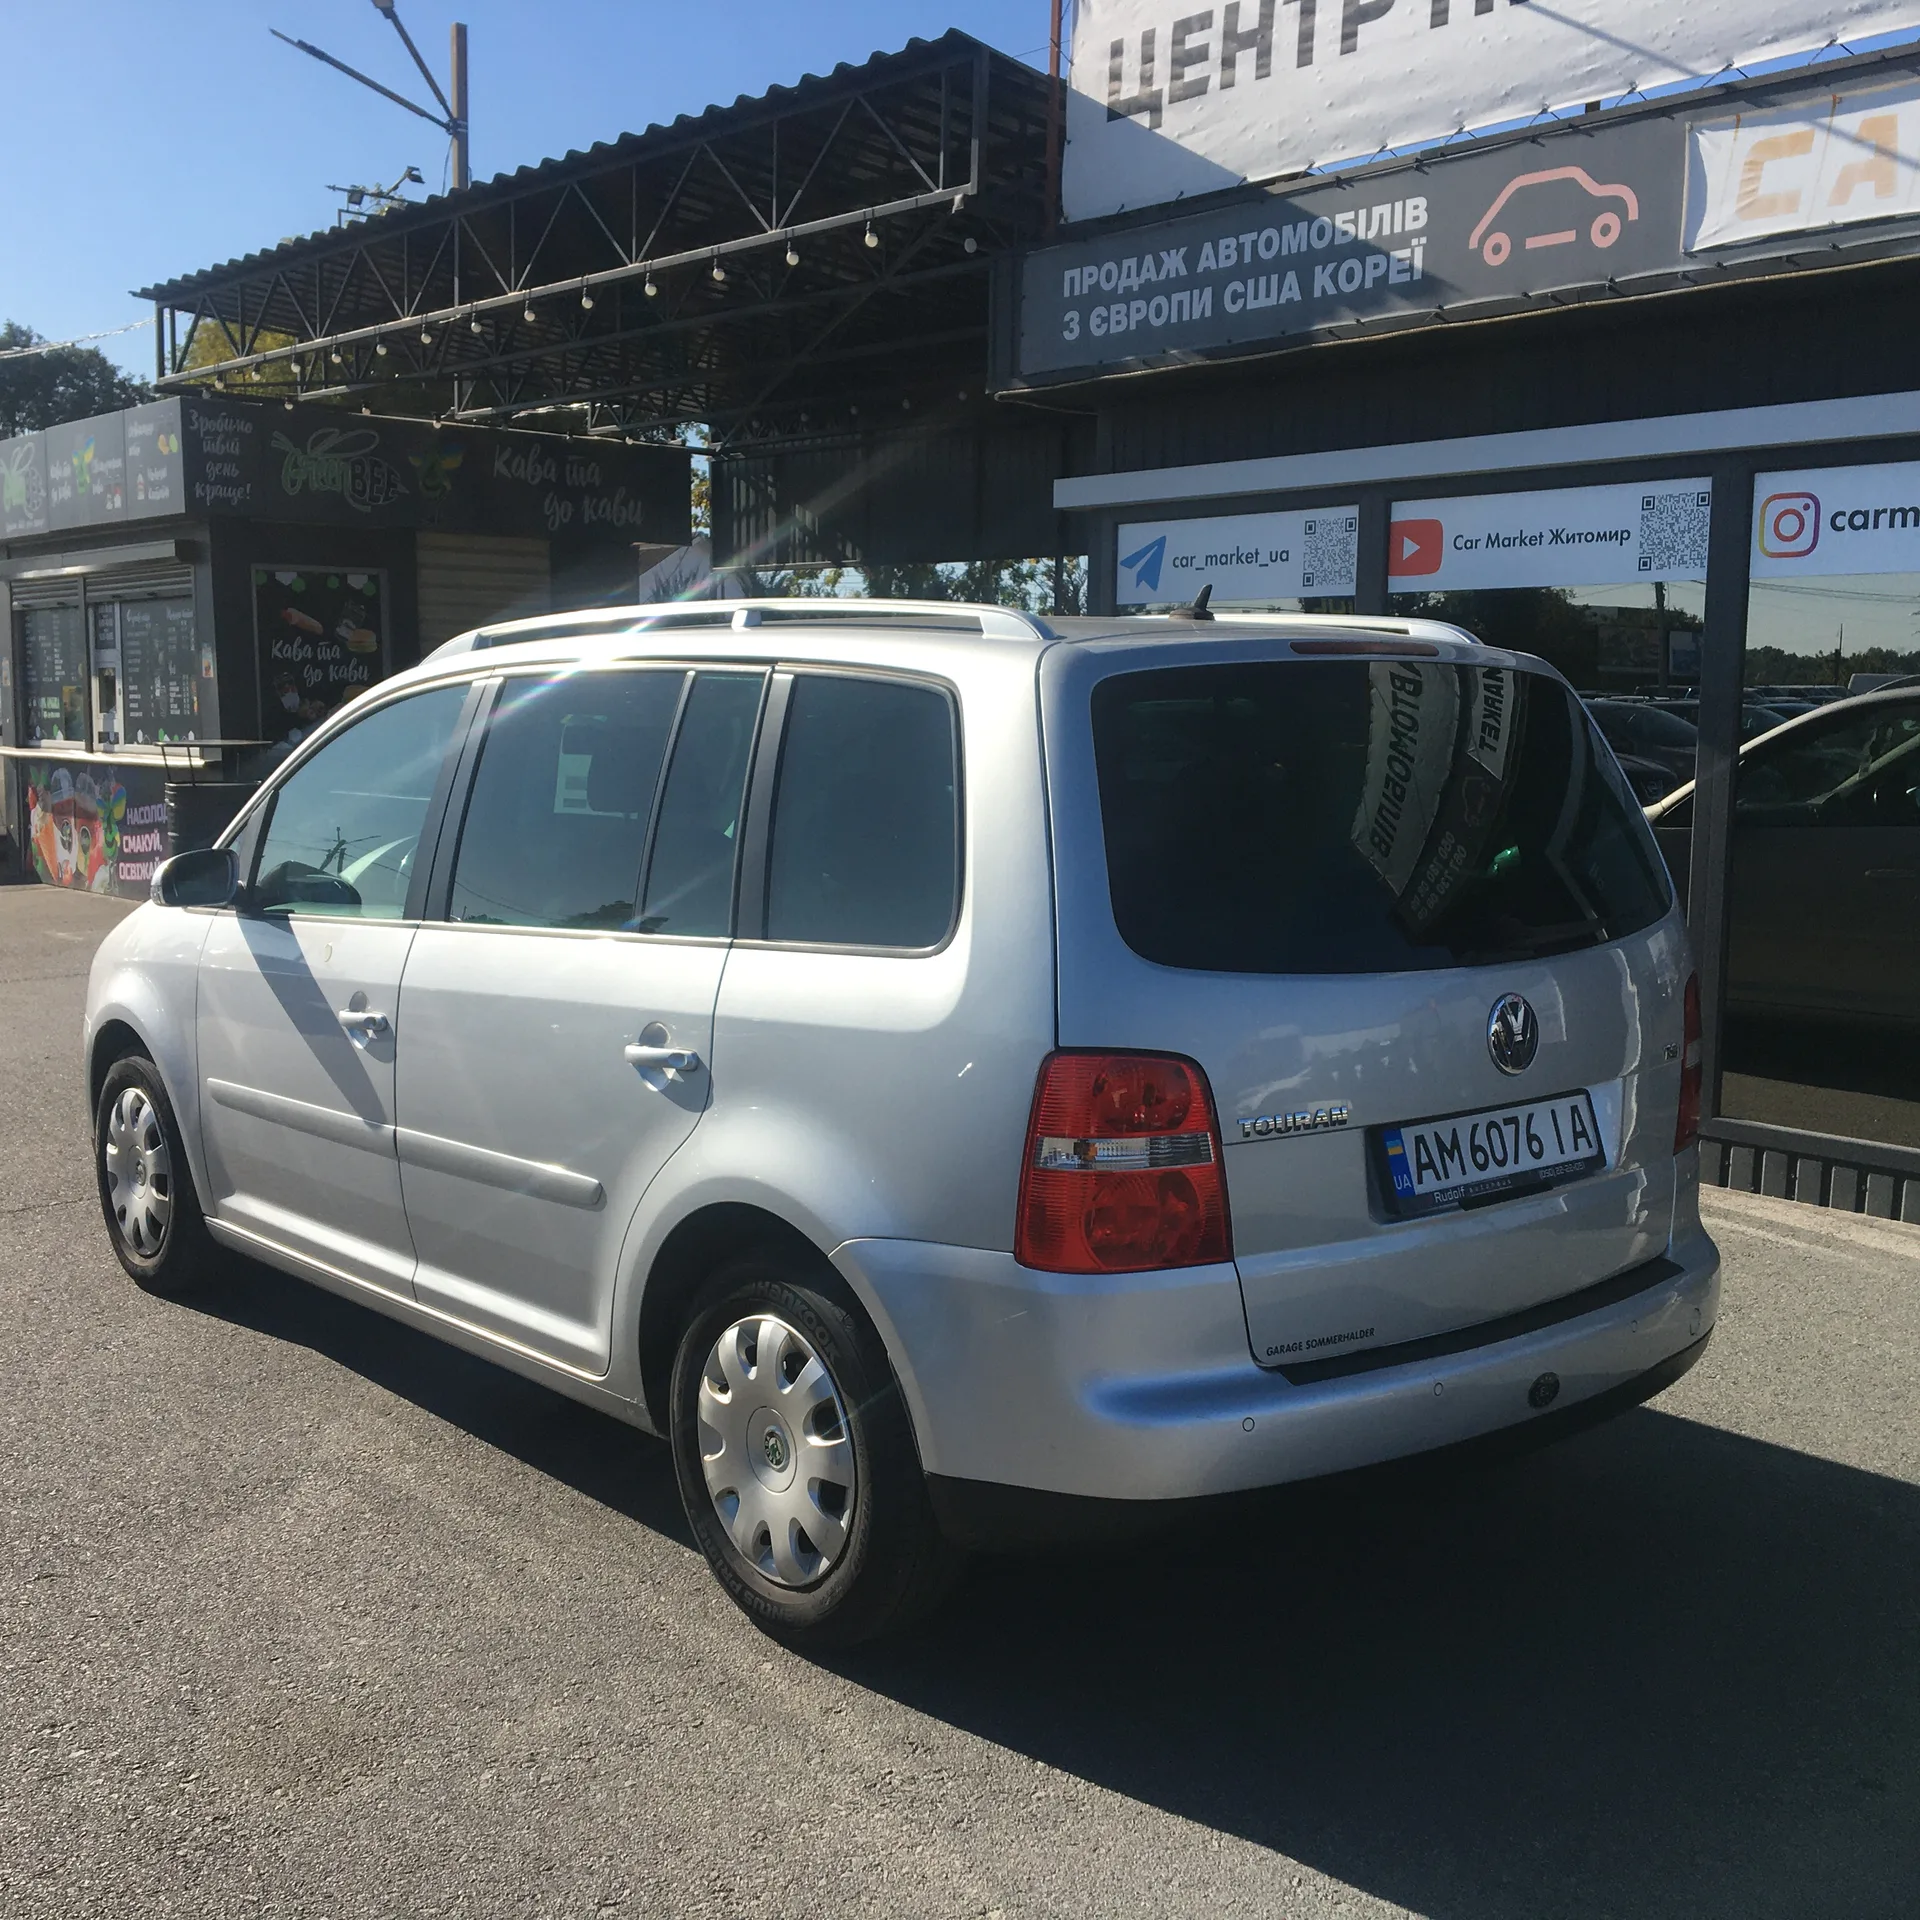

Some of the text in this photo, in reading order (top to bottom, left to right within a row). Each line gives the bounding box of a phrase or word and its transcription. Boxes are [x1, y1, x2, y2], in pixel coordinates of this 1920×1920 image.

[1063, 196, 1428, 298] ПРОДАЖ АВТОМОБІЛІВ
[1062, 236, 1428, 341] З ЄВРОПИ США КОРЕЇ
[189, 409, 253, 437] Зробимо
[206, 459, 240, 481] день
[493, 444, 558, 485] Кава
[194, 482, 252, 506] краще!
[544, 486, 645, 531] до кави
[1830, 506, 1920, 532] carm
[1453, 527, 1631, 550] Car Market Житомир
[1172, 546, 1290, 571] car_market_ua
[271, 636, 313, 661] Кава
[303, 657, 369, 687] до кави
[1237, 1106, 1348, 1138] TOURAN
[1395, 1175, 1411, 1190] UA
[1434, 1186, 1465, 1203] Rudolf
[1266, 1328, 1375, 1357] GARAGE SOMMERHALDER
